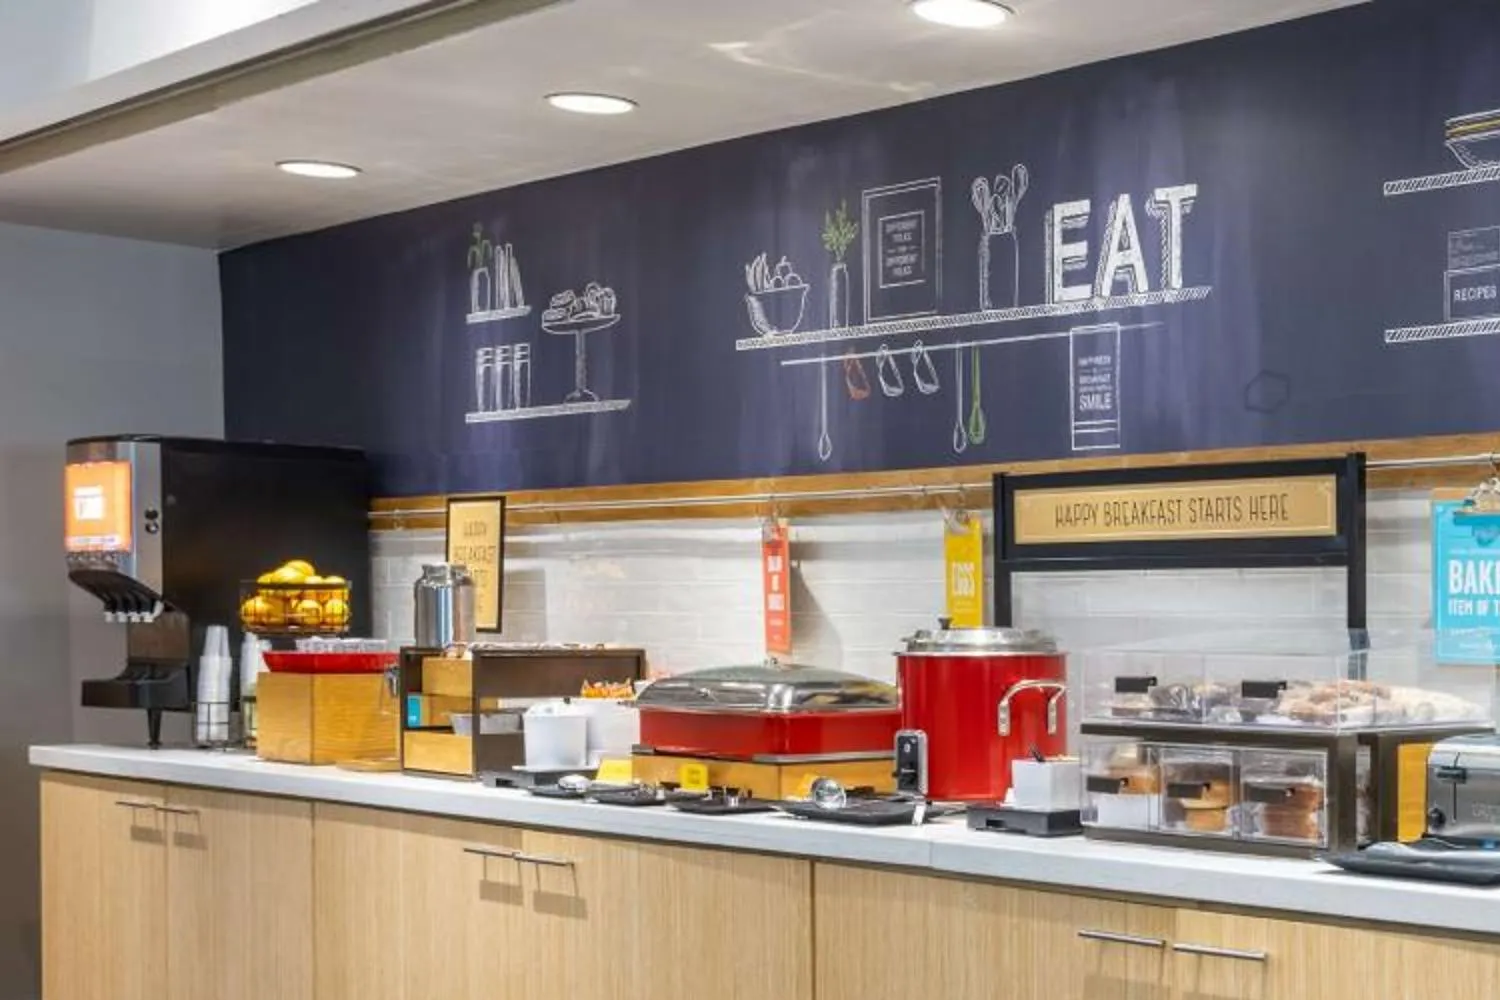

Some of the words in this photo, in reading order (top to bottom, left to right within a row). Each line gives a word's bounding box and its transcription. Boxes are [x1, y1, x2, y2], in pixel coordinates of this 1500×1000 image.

[1045, 184, 1197, 305] EAT
[1454, 285, 1497, 301] RECIPES
[1080, 392, 1112, 411] SMILE
[1055, 503, 1099, 529] HAPPY
[1104, 499, 1184, 527] BREAKFAST
[1189, 494, 1243, 524] STARTS
[1249, 493, 1289, 522] HERE
[1448, 600, 1473, 616] ITEM
[1477, 600, 1489, 616] OF
